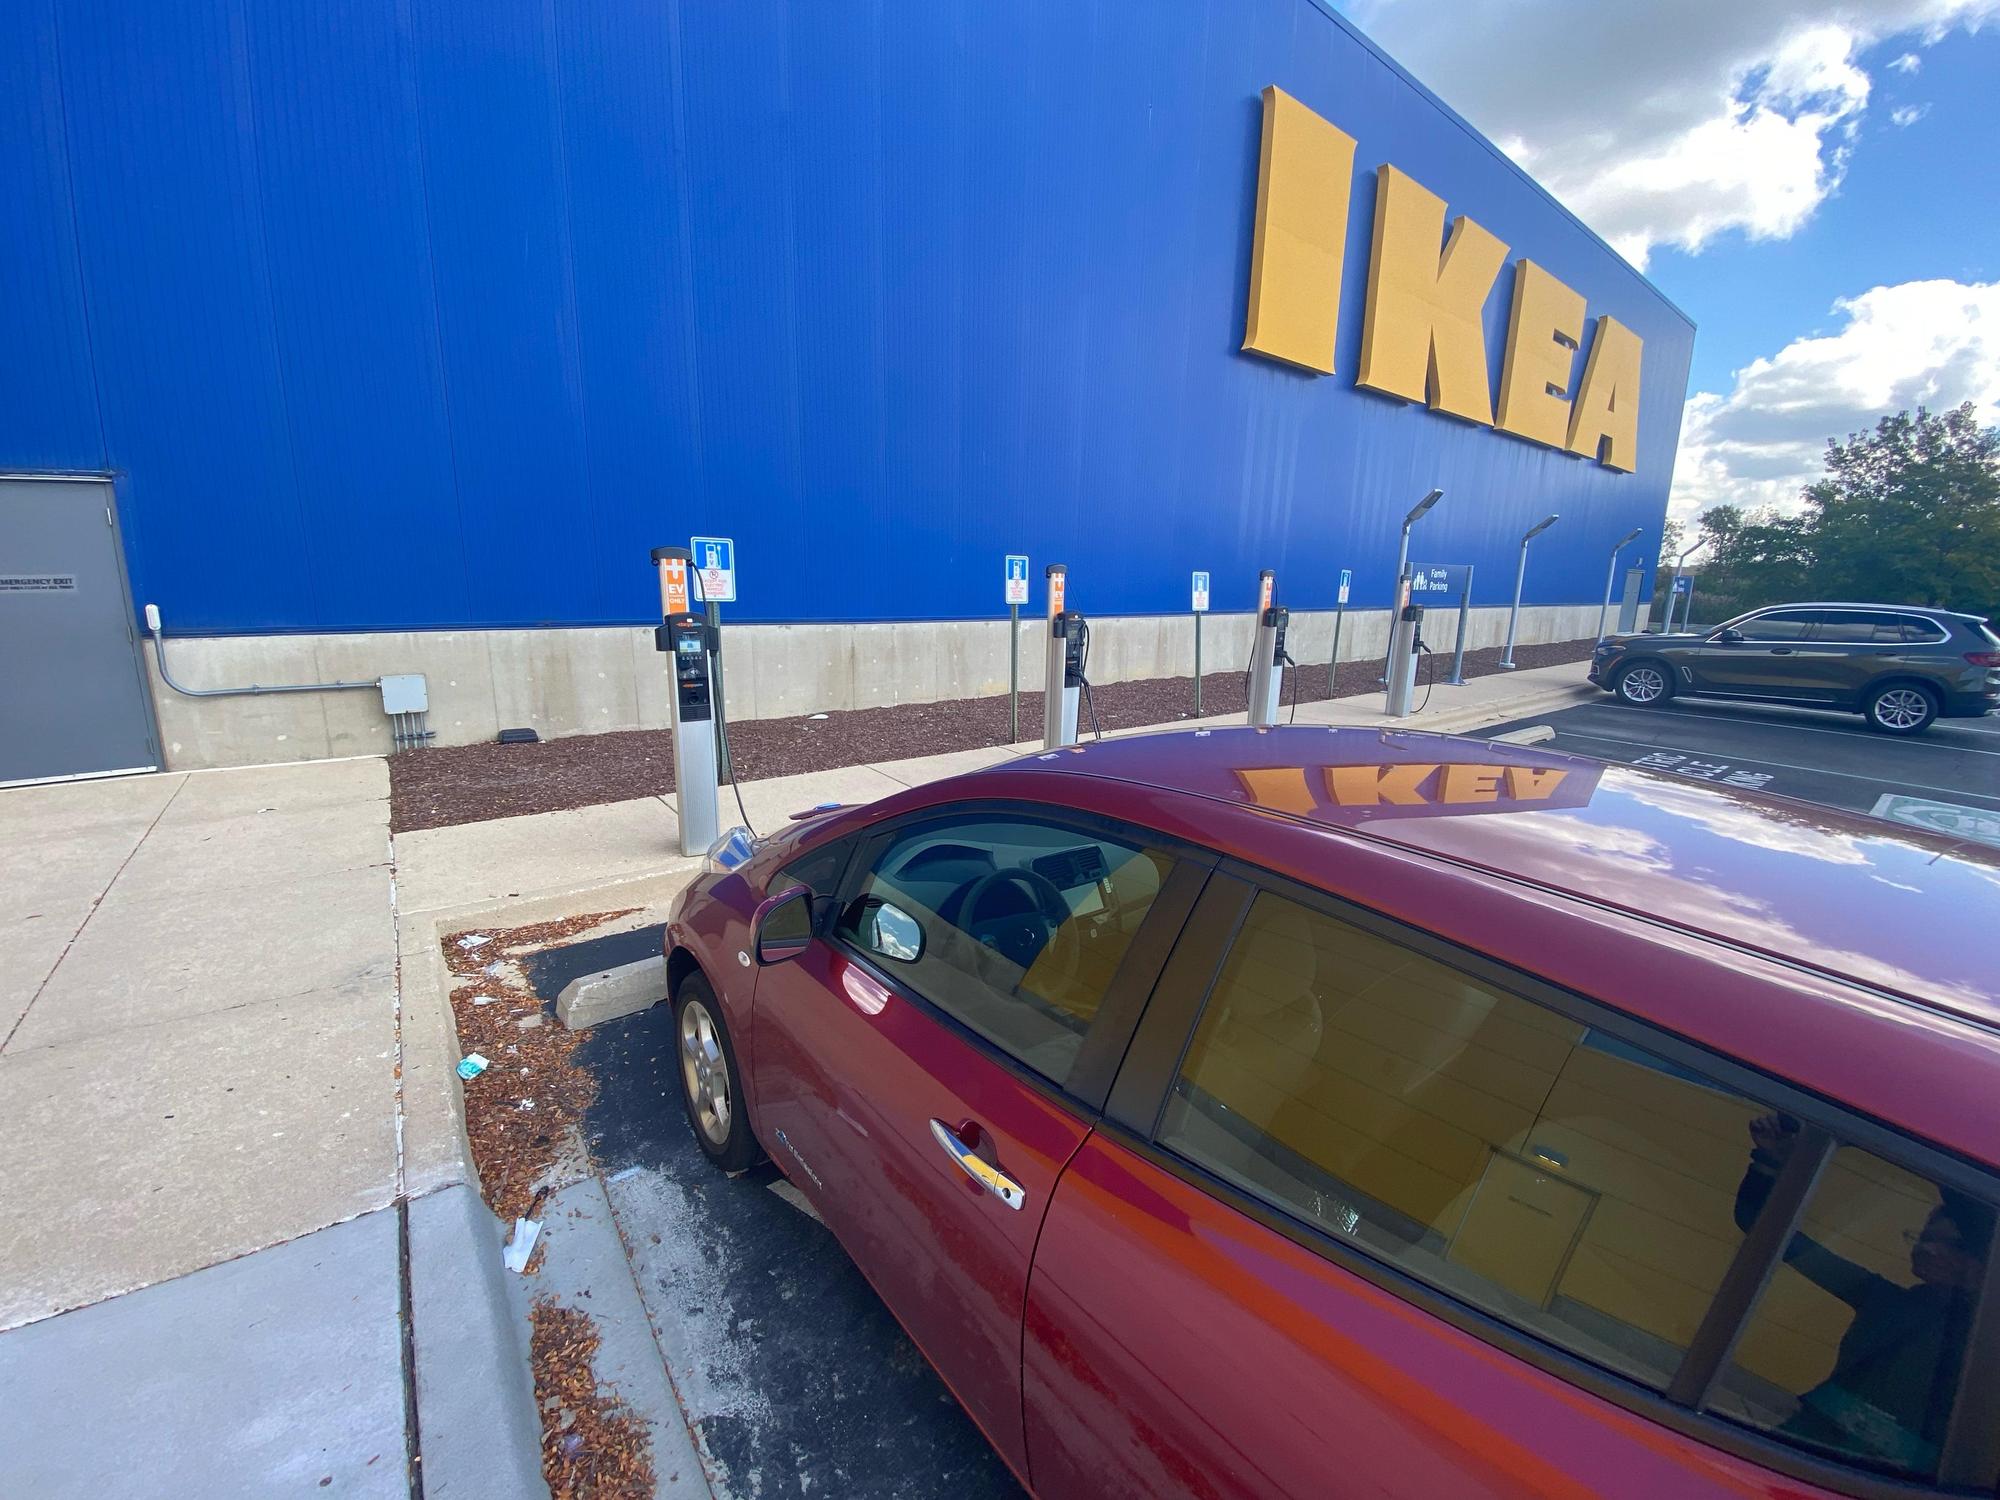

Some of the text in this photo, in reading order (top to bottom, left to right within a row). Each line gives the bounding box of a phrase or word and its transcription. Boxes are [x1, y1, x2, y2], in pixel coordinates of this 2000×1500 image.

[1240, 84, 1643, 475] IKEA
[1431, 568, 1448, 580] Family
[668, 583, 684, 594] EV
[1429, 581, 1448, 593] Parking
[1632, 752, 1687, 768] TRIC
[1676, 760, 1731, 777] CLE
